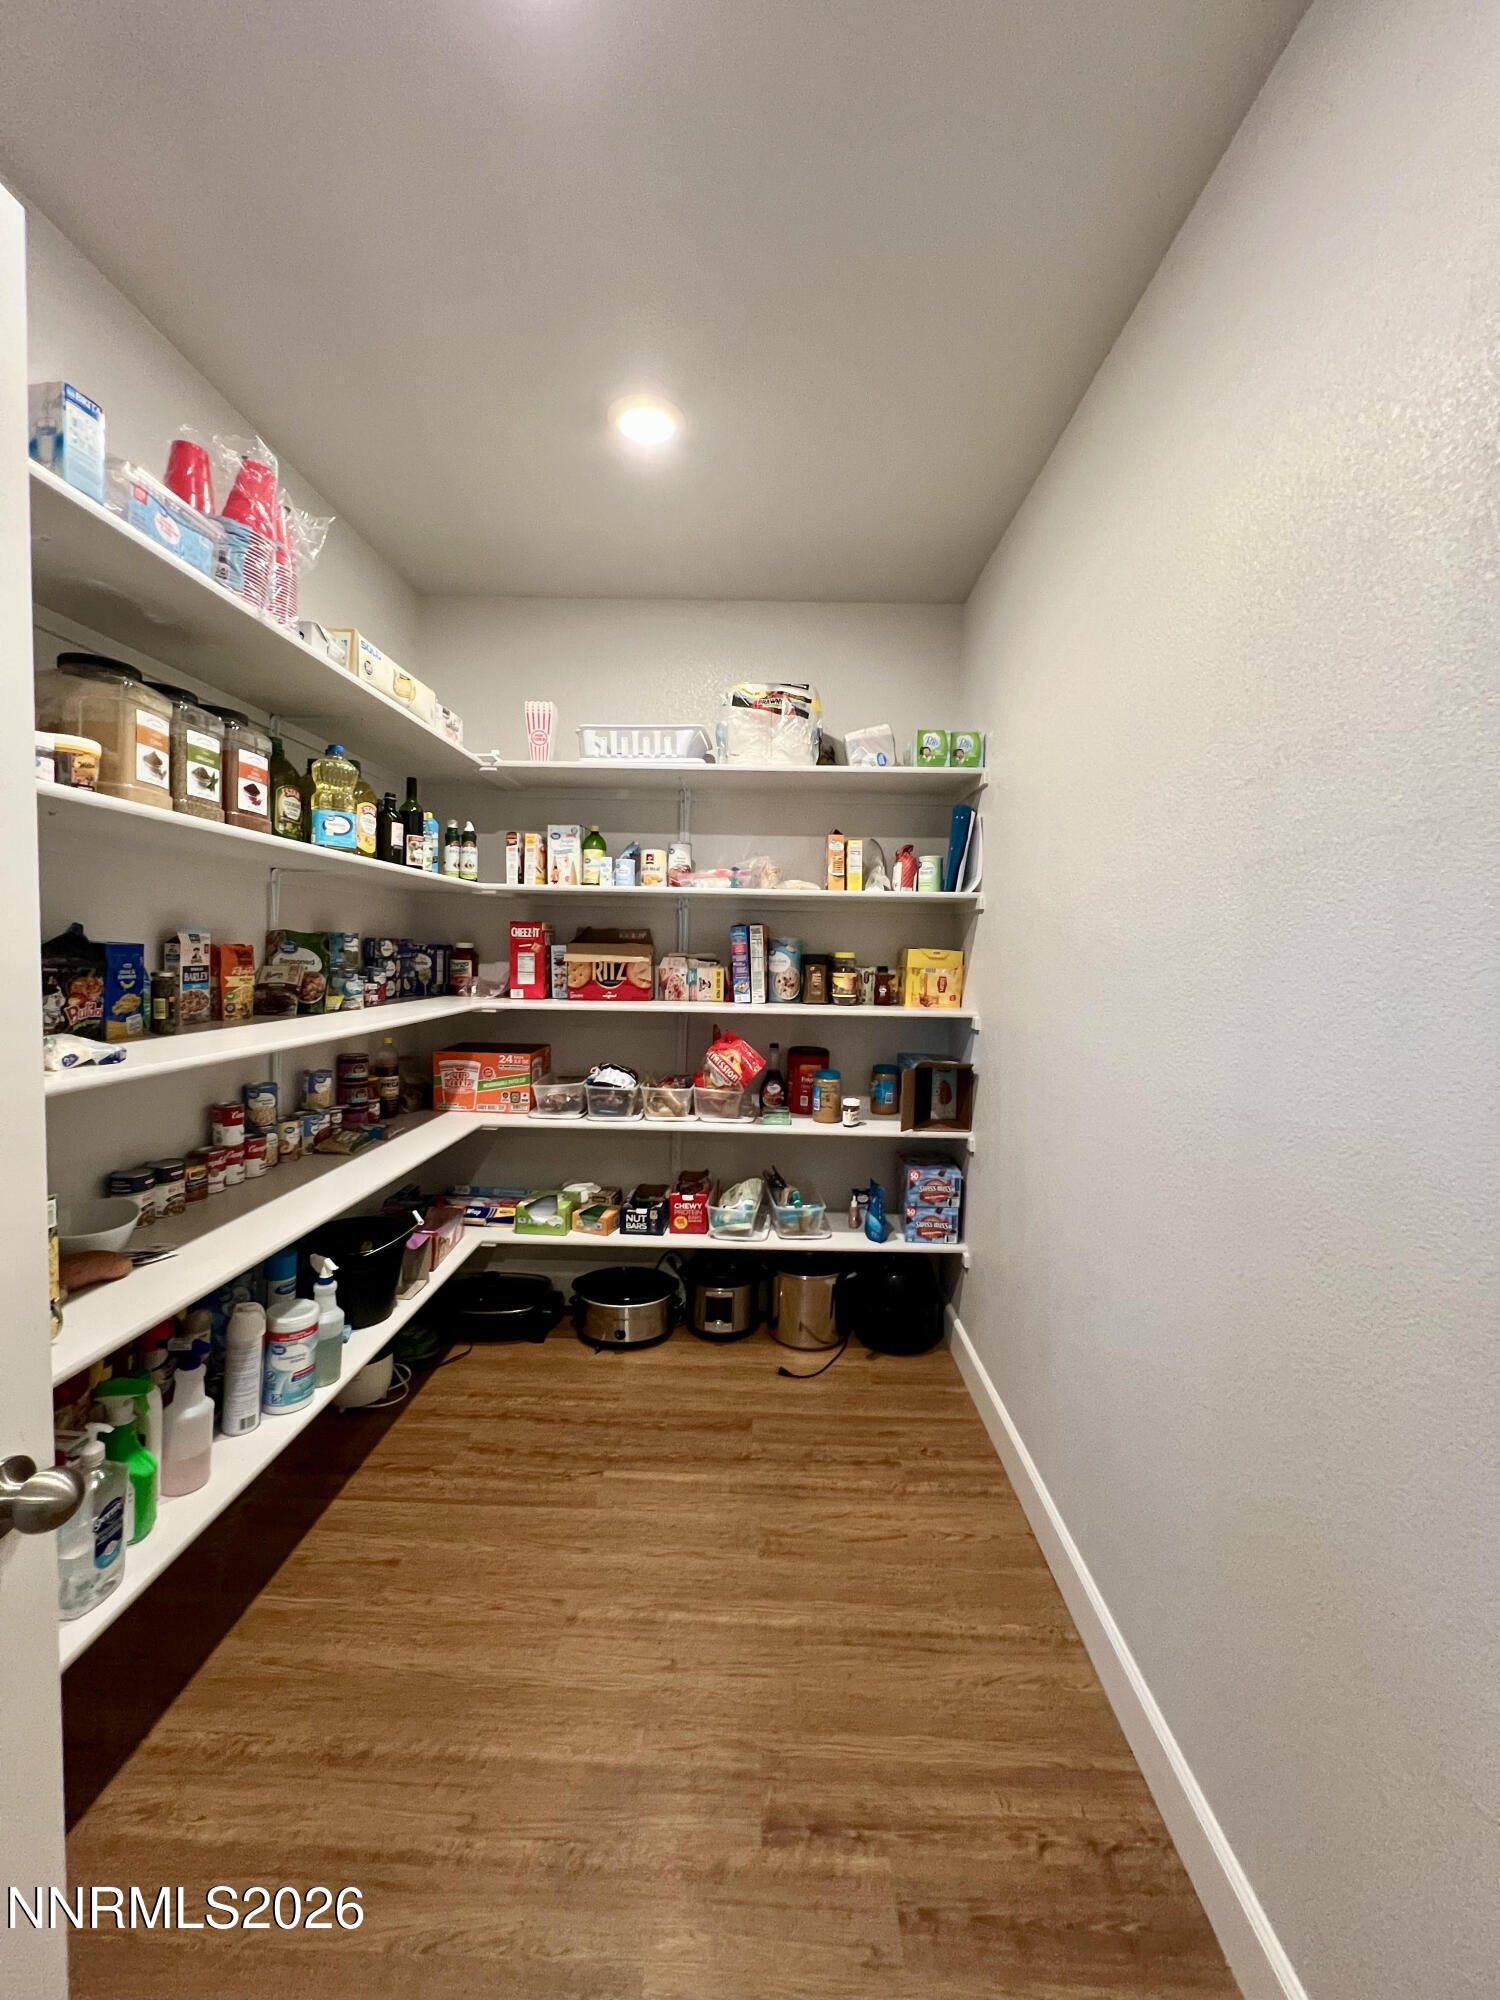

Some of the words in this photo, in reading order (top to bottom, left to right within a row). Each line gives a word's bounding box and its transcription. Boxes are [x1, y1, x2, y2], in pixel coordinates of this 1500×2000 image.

[592, 961, 628, 982] RITZ
[183, 971, 208, 982] BARLEY
[498, 1055, 513, 1064] 24
[674, 1202, 703, 1210] CHEWY
[625, 1214, 647, 1223] NUT
[625, 1222, 648, 1230] BARS
